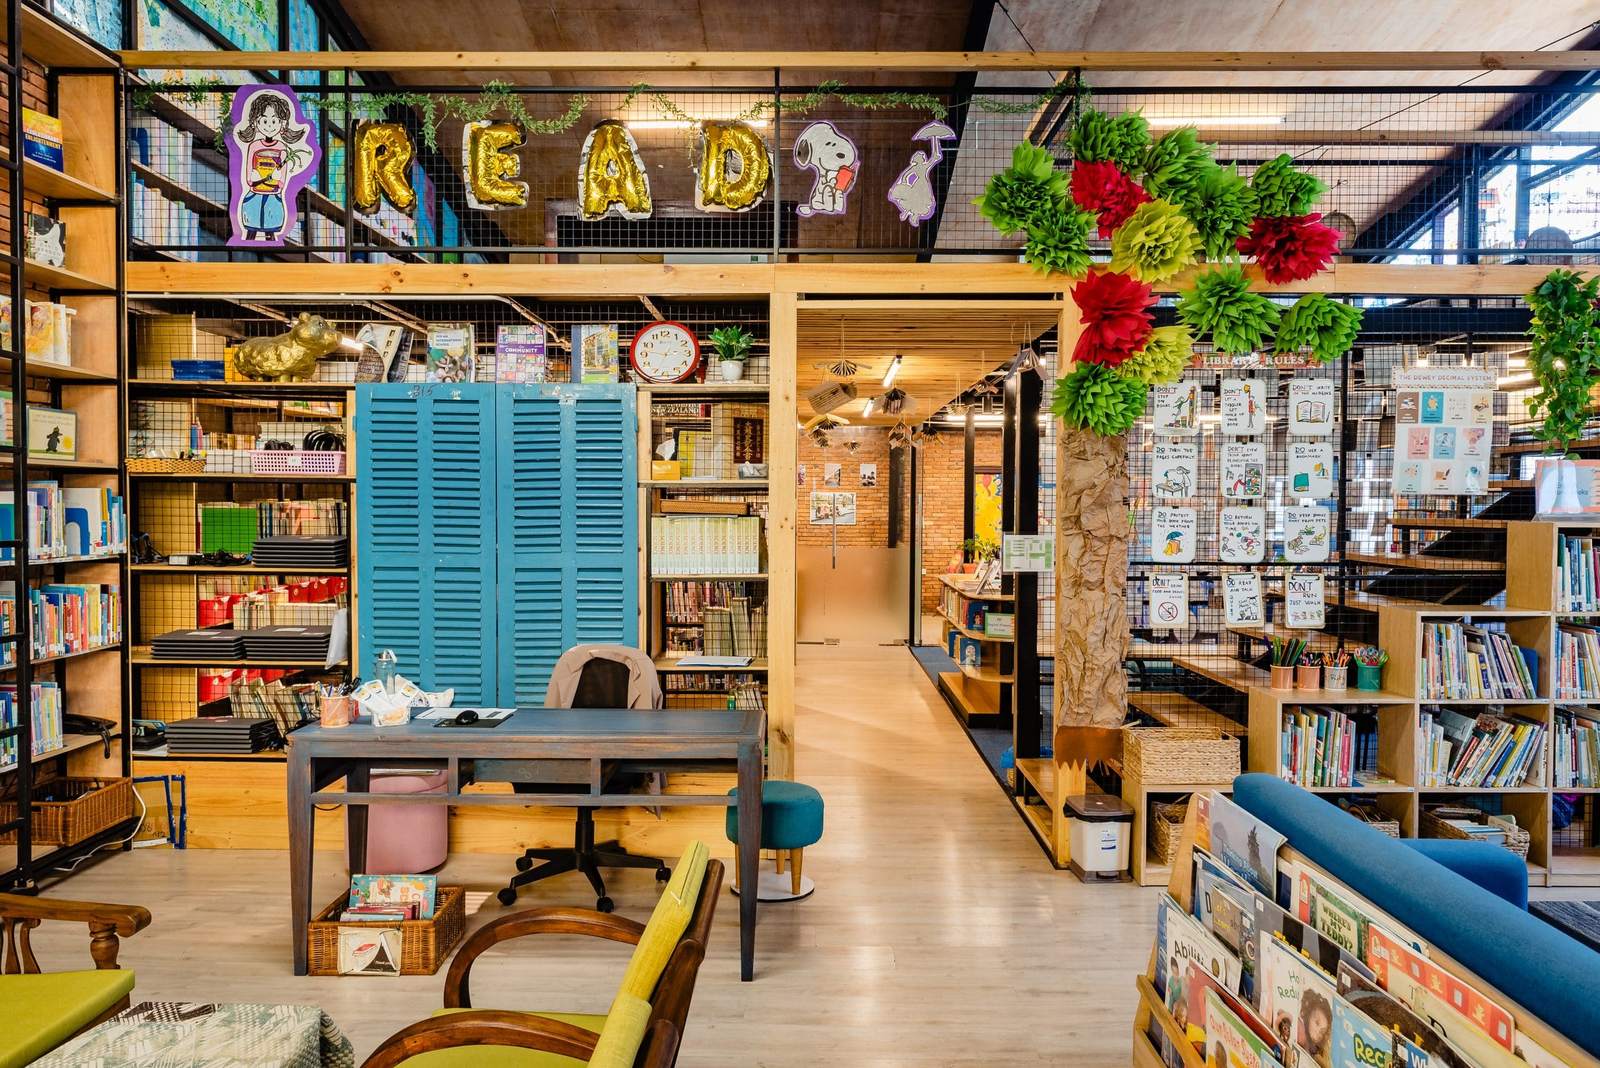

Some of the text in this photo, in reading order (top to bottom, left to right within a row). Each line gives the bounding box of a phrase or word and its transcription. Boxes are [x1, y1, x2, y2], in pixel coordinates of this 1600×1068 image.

[353, 120, 770, 221] READ
[1203, 354, 1305, 366] LIBRARY RULES
[1288, 580, 1313, 592] DON'T
[1321, 903, 1352, 932] WHERE'S
[1320, 918, 1354, 953] TEDDY?
